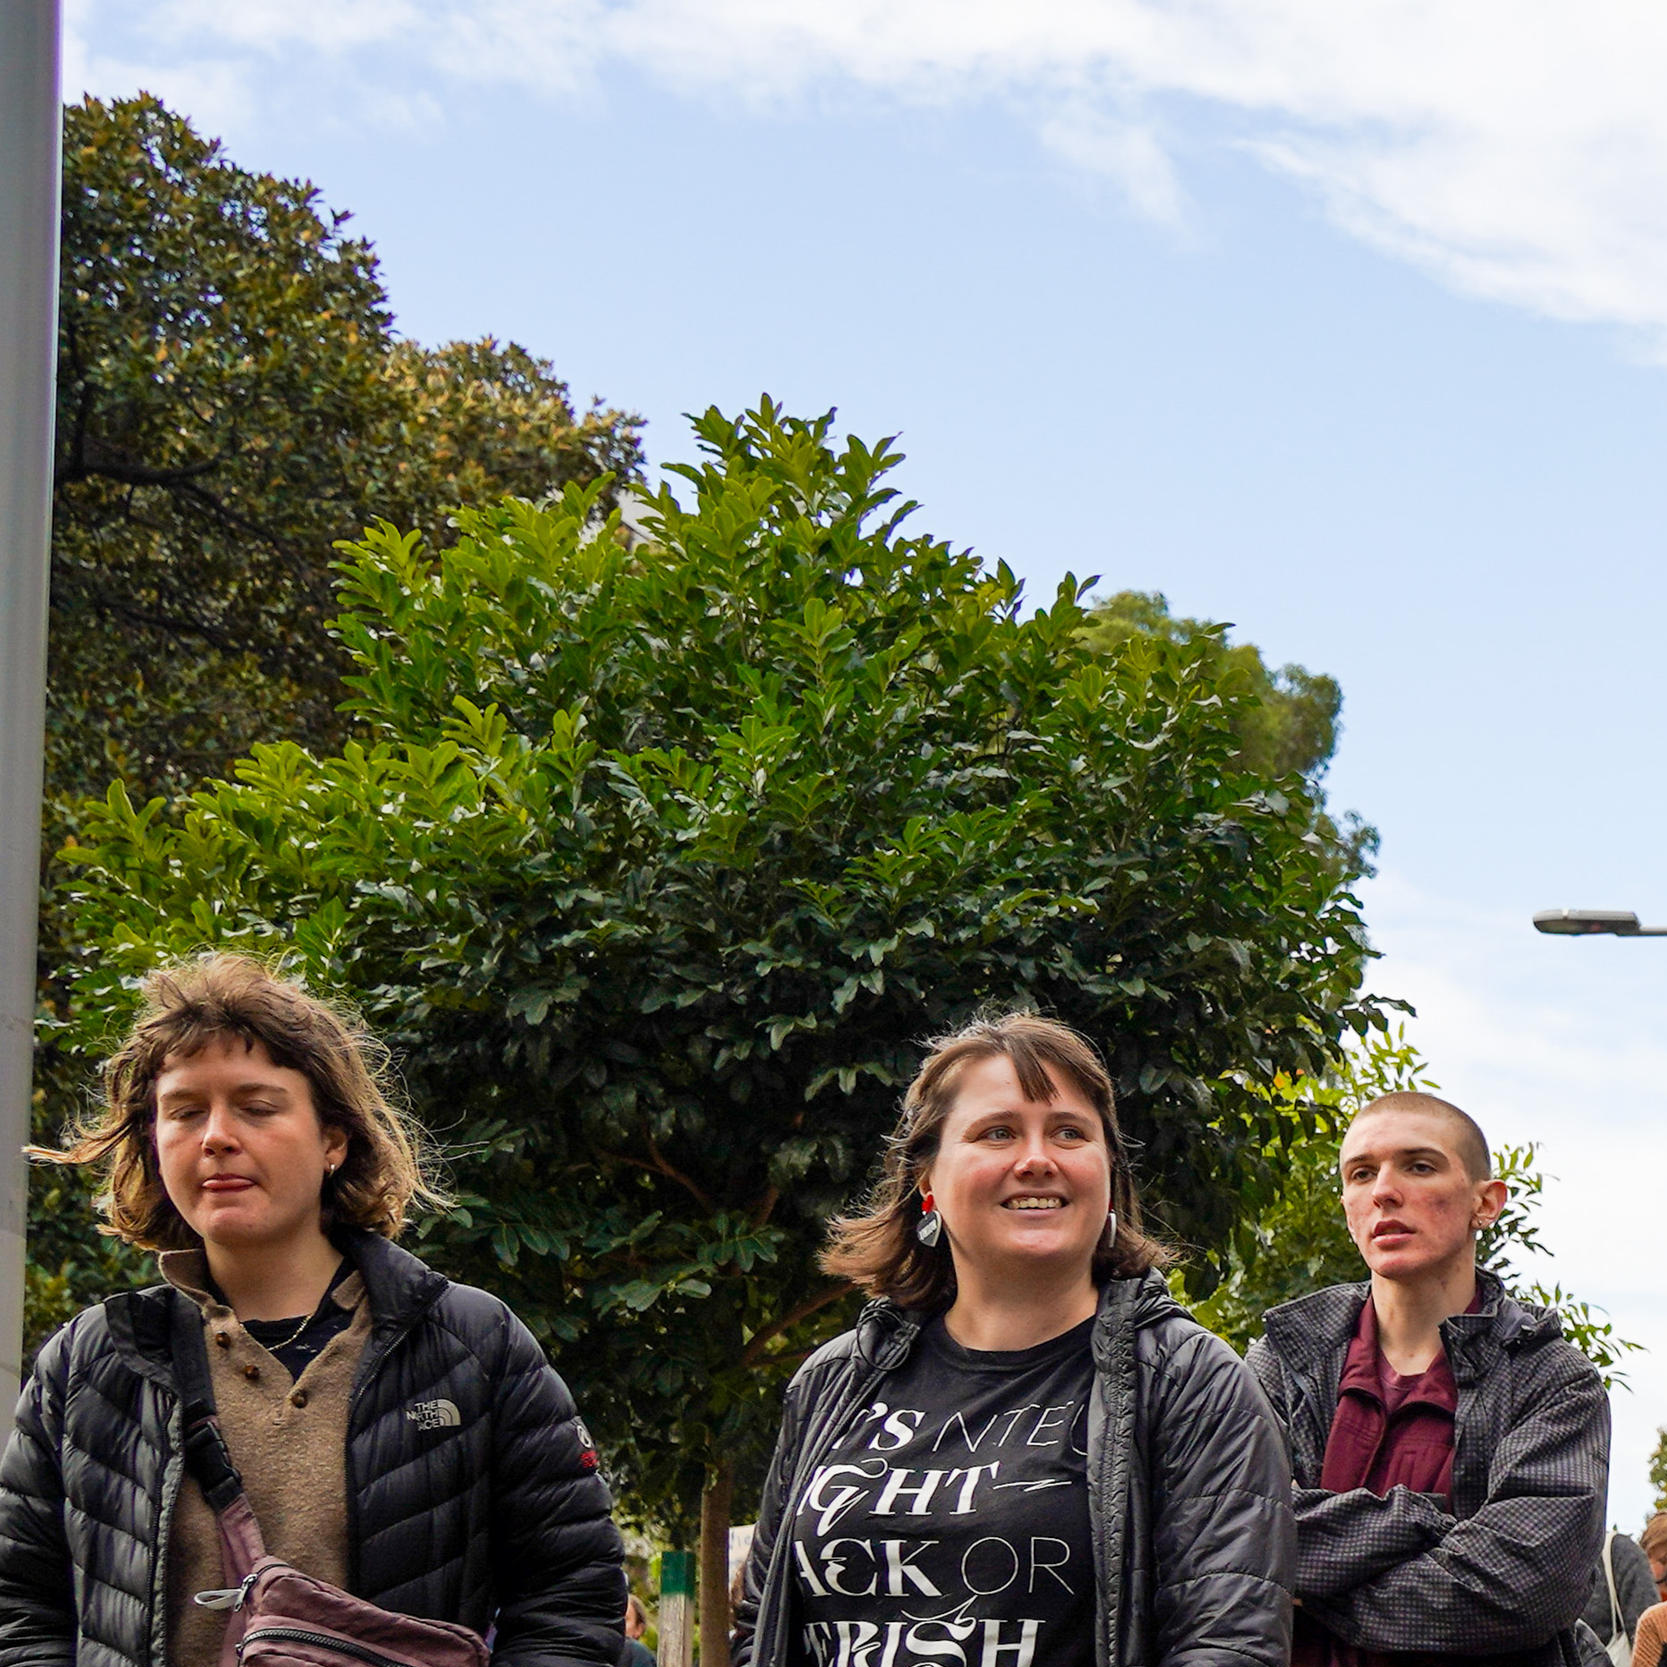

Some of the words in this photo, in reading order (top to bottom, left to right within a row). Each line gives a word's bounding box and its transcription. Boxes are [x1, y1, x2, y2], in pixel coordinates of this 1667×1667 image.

[415, 1400, 438, 1411] THE
[406, 1409, 439, 1421] NRTH
[961, 1536, 1075, 1596] OR
